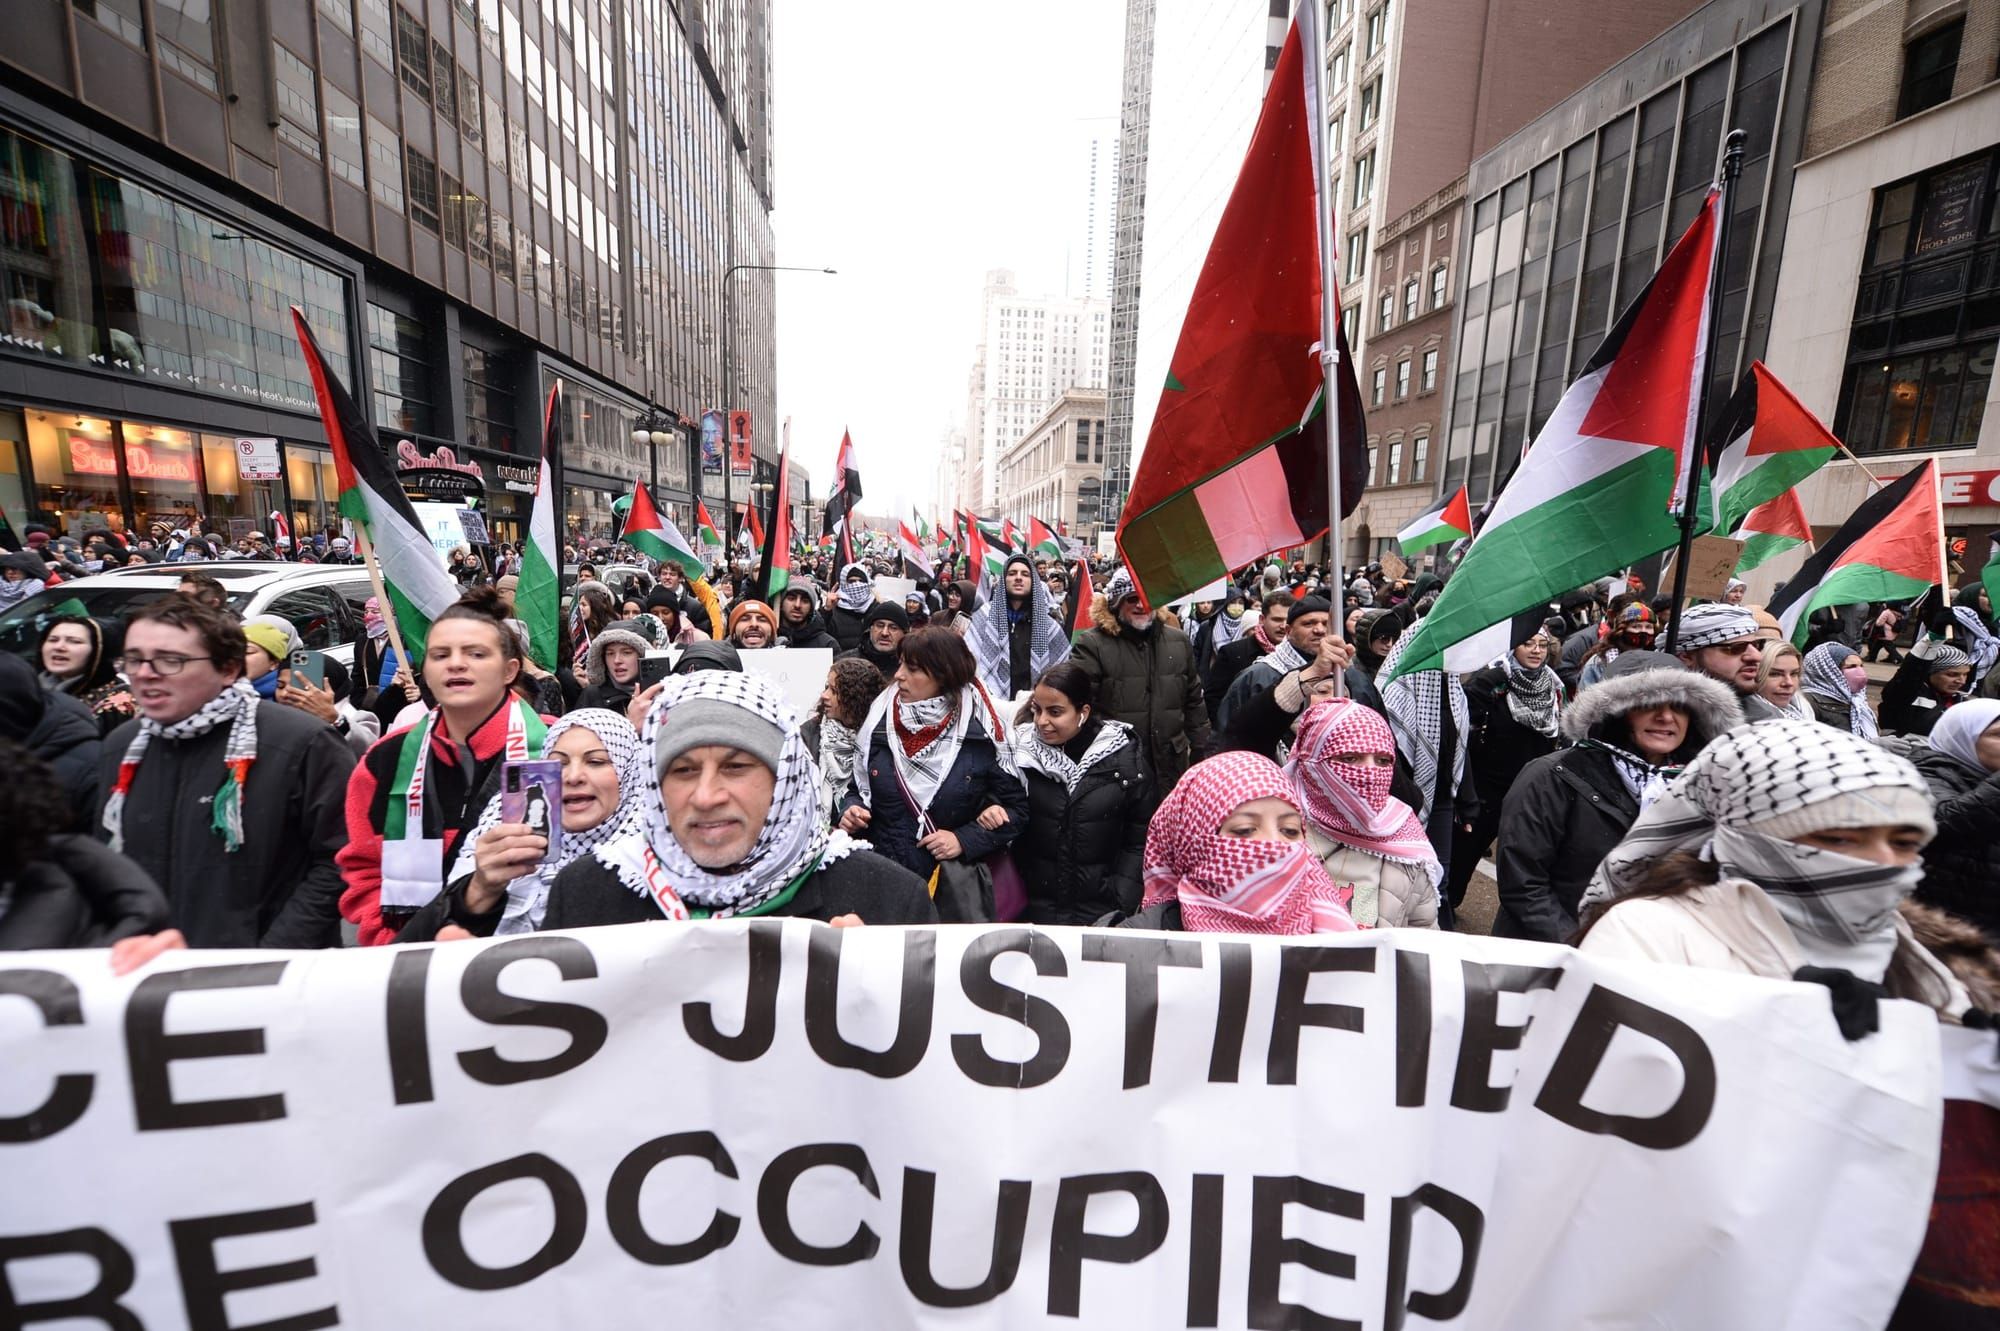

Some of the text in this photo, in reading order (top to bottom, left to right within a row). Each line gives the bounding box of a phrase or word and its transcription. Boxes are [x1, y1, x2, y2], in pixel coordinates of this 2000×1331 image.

[241, 385, 259, 397] The
[260, 390, 284, 402] heat's
[285, 396, 311, 407] around
[70, 440, 190, 480] Stan Donuts
[436, 446, 483, 478] Donuts
[438, 521, 449, 530] IT
[0, 922, 1716, 1151] CE IS JUSTIFIED
[422, 1130, 1485, 1331] OCCUPIED
